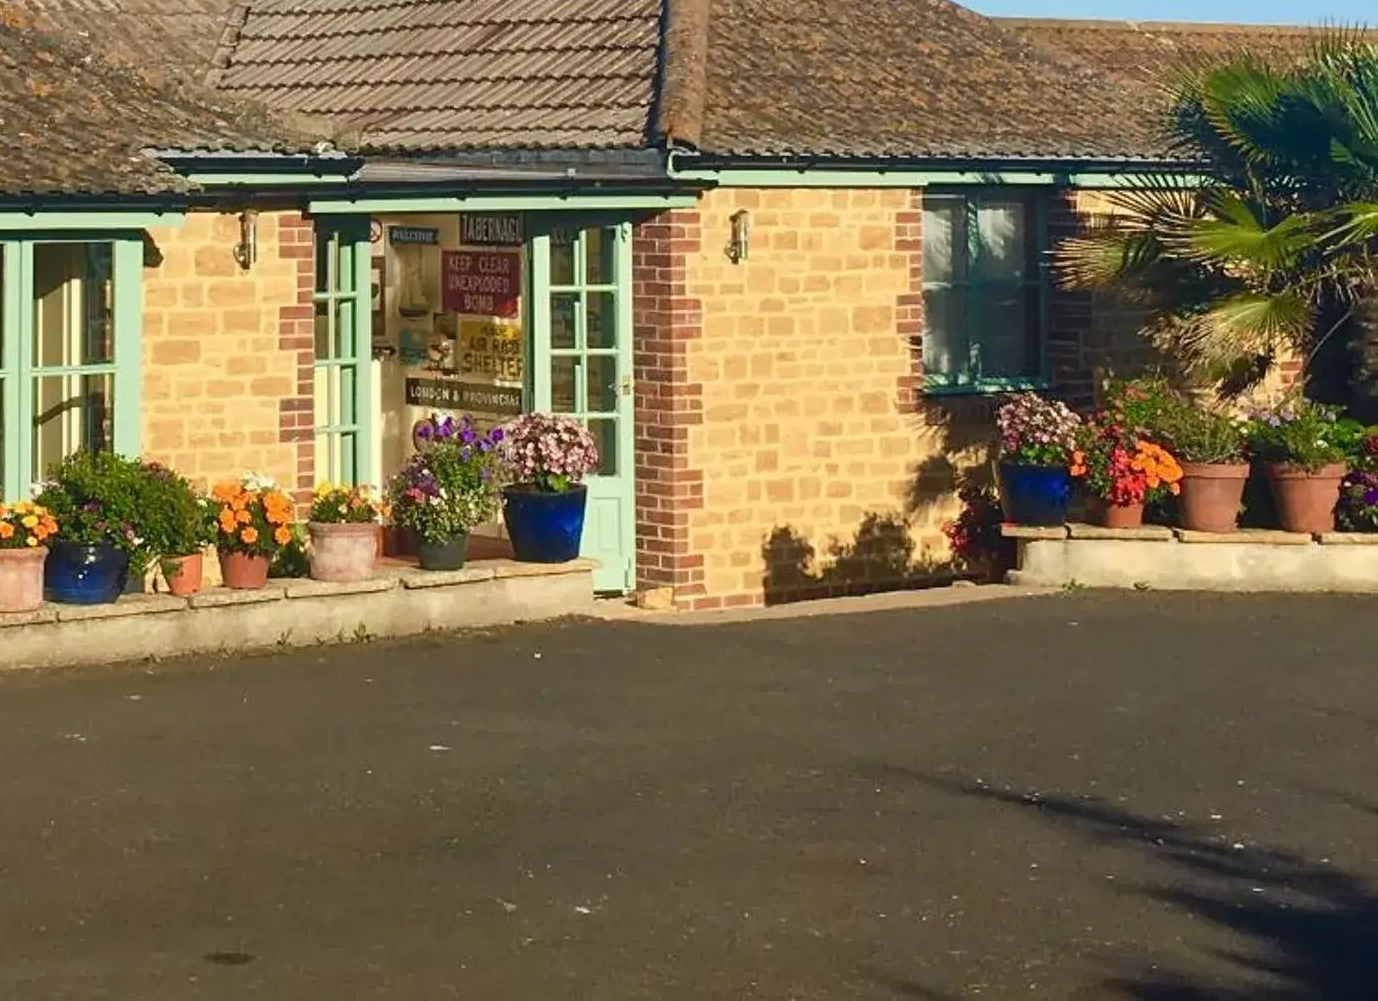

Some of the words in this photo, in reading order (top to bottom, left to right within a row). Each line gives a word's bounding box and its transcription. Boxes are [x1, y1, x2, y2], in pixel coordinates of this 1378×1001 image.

[448, 255, 472, 272] KEEP
[479, 256, 510, 274] CLEAR
[448, 274, 510, 294] UNEXPLODED
[464, 294, 494, 311] BOMB
[410, 385, 450, 401] LONDON
